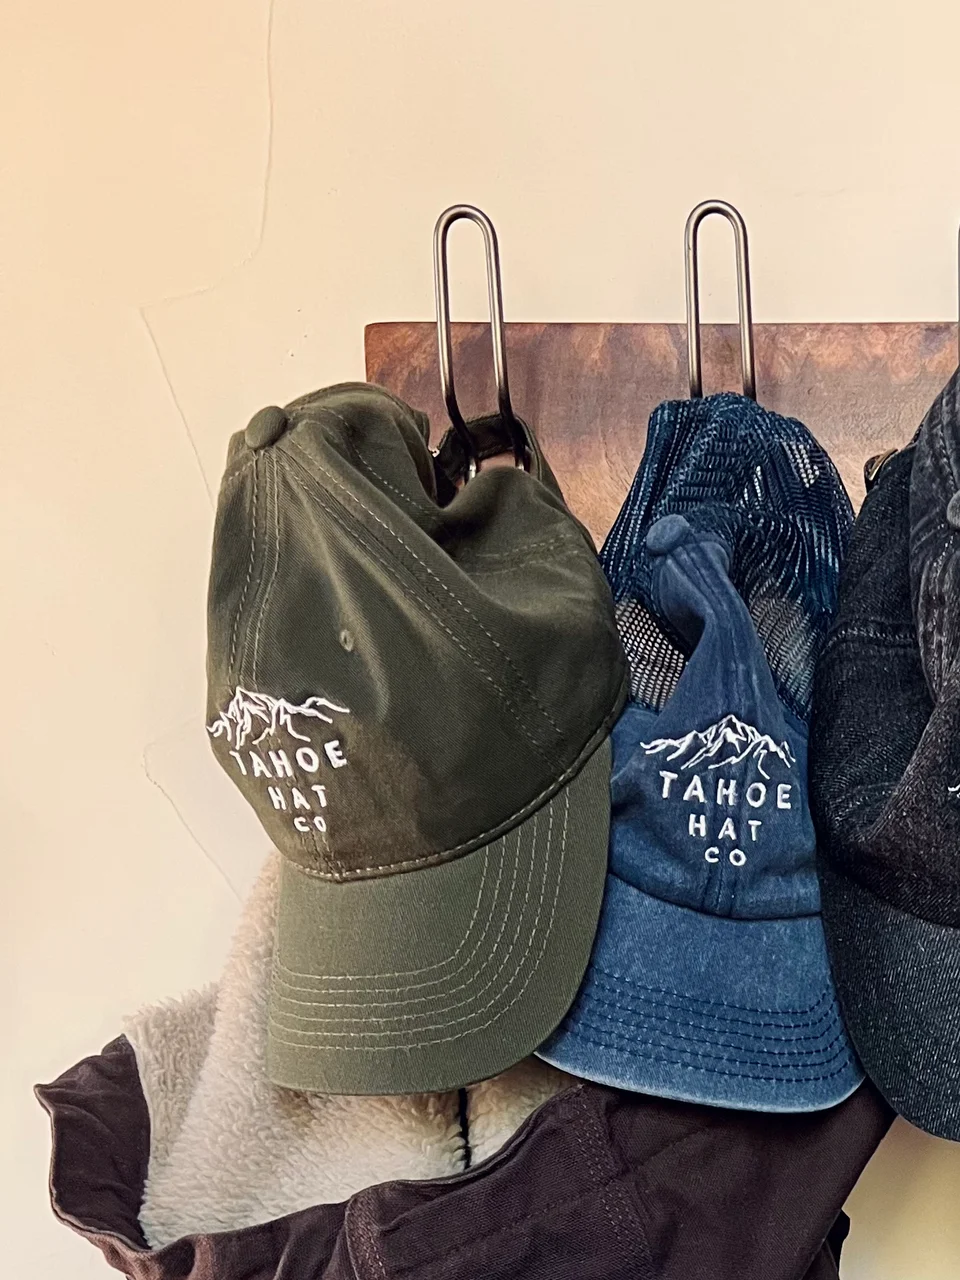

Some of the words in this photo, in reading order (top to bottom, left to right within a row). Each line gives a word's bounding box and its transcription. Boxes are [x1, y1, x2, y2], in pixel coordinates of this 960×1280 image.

[229, 740, 348, 778] TAHOE
[267, 784, 328, 810] HAT
[658, 770, 793, 810] TAHOE
[293, 815, 328, 833] CO
[688, 813, 763, 842] HAT
[704, 846, 748, 867] CO
